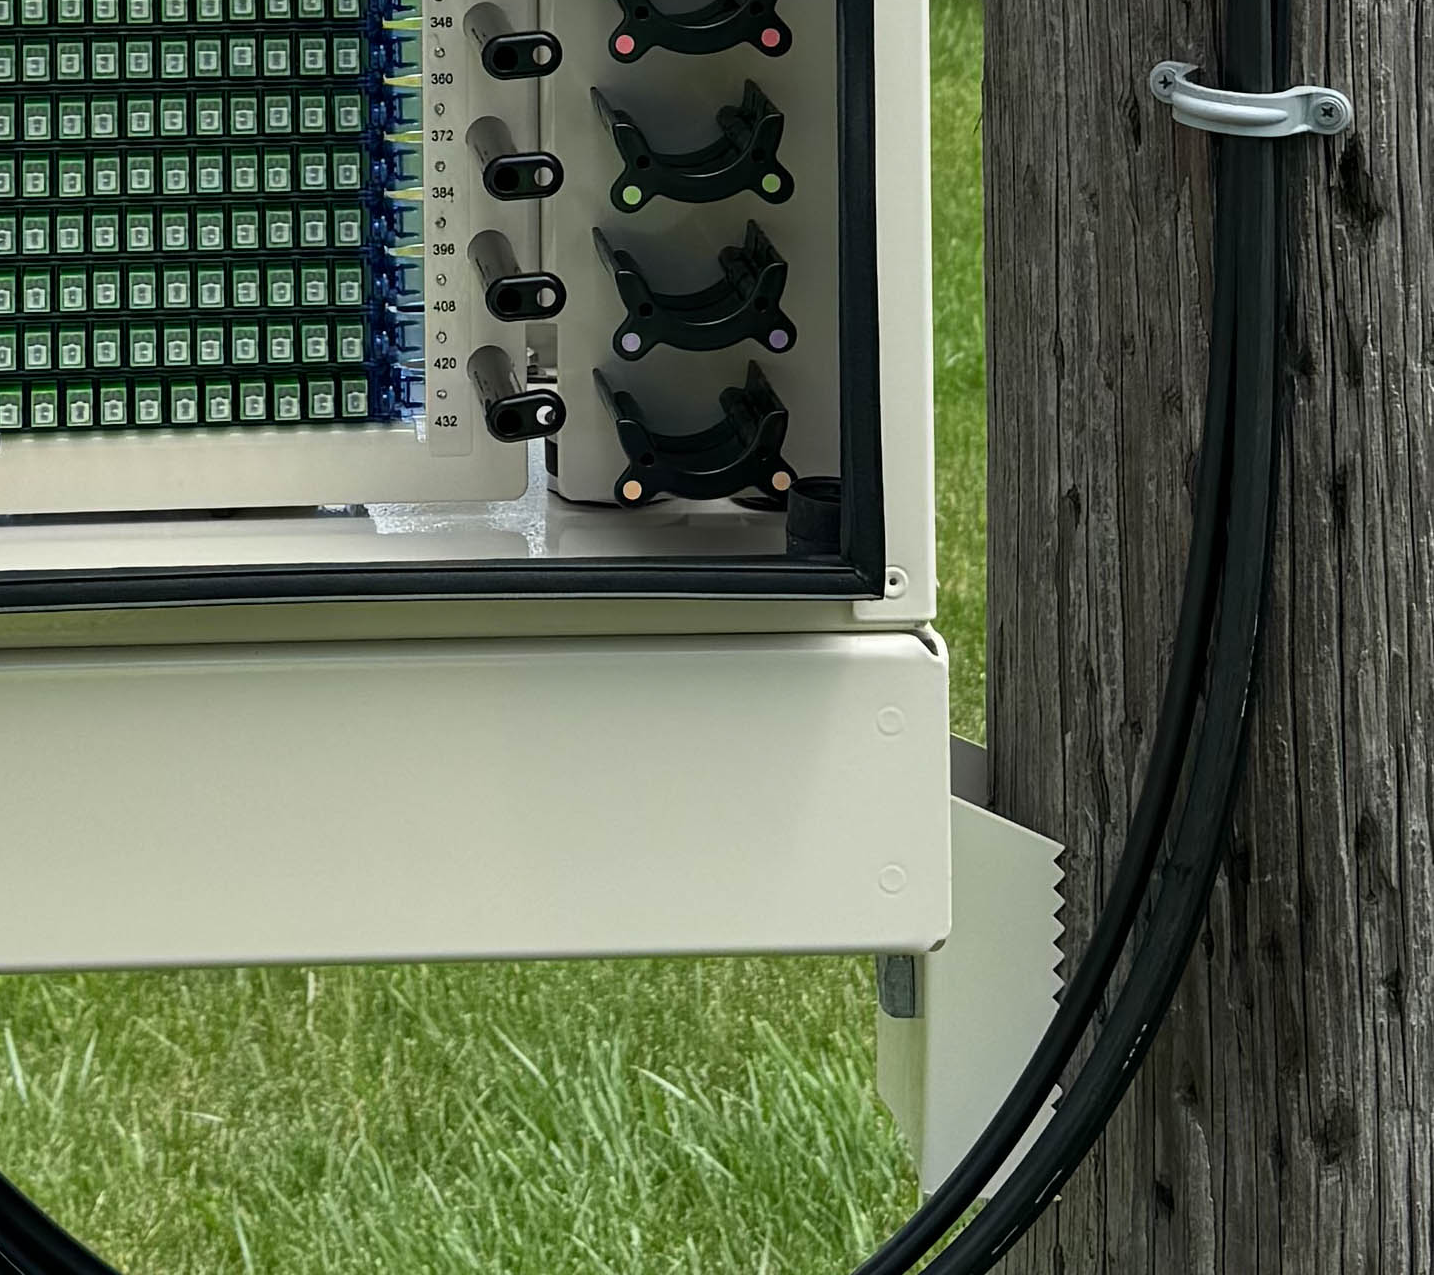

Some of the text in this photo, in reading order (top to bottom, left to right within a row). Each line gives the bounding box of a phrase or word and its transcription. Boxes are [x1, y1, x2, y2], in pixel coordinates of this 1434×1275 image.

[431, 129, 454, 142] 372
[432, 186, 455, 199] 384
[433, 300, 456, 313] 408
[433, 357, 457, 370] 420
[434, 415, 458, 428] 432
